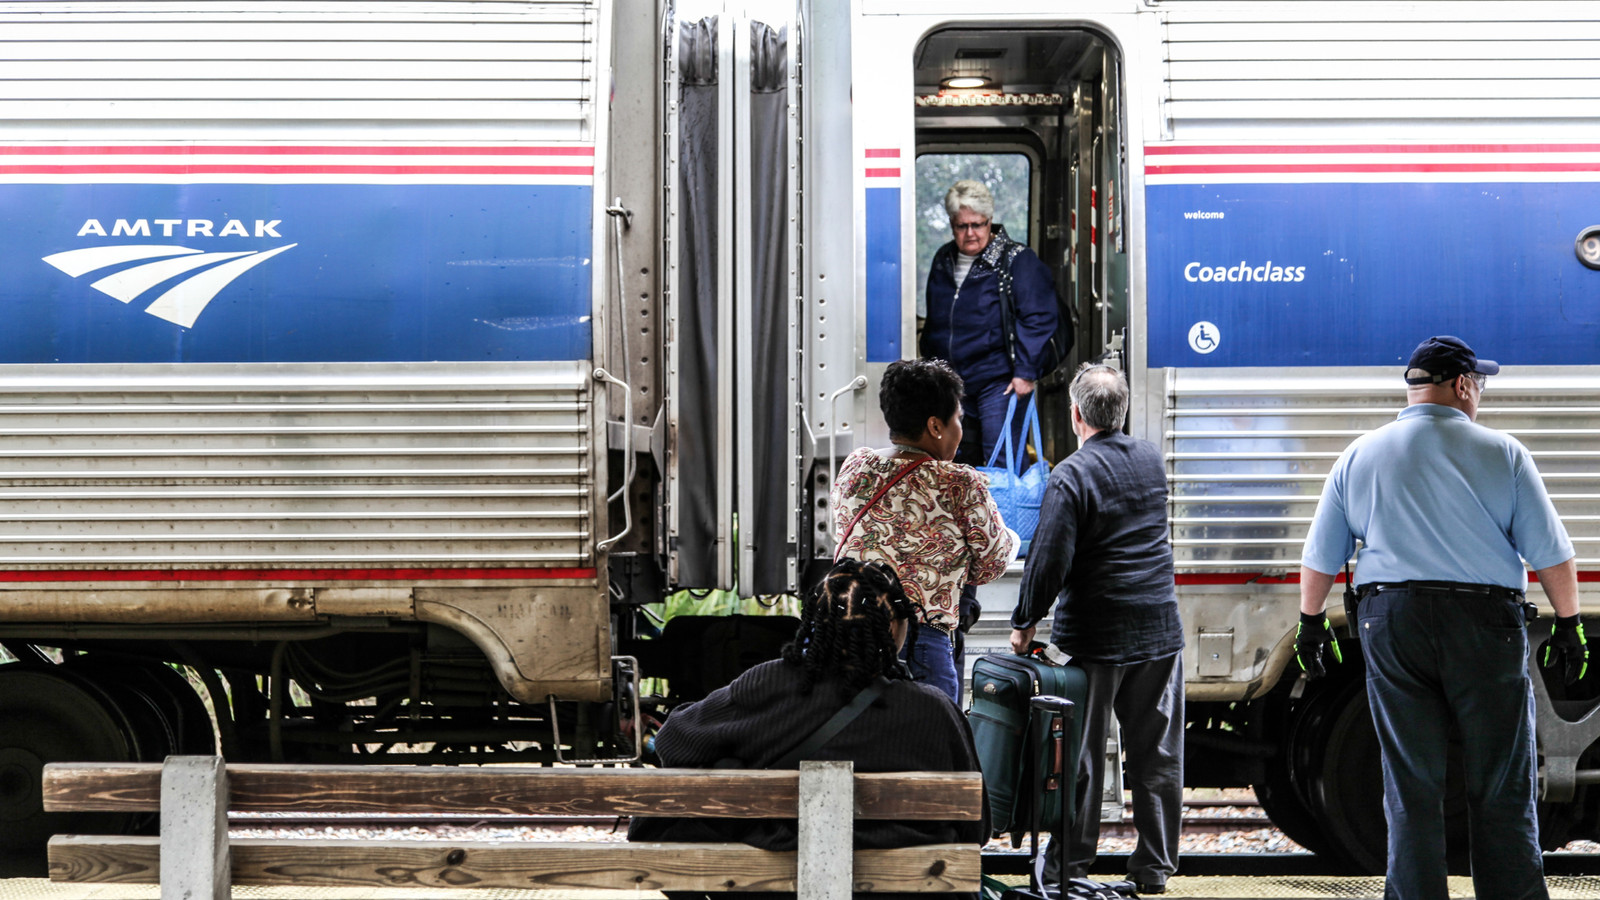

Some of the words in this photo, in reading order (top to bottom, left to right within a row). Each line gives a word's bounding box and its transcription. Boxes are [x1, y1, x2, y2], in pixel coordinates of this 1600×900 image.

[945, 96, 987, 105] BETWEEN
[1017, 95, 1062, 104] PLATFORM
[1183, 210, 1225, 220] welcome
[76, 218, 283, 239] AMTRAK
[1183, 260, 1306, 283] Coachclass
[965, 646, 988, 655] UTION!
